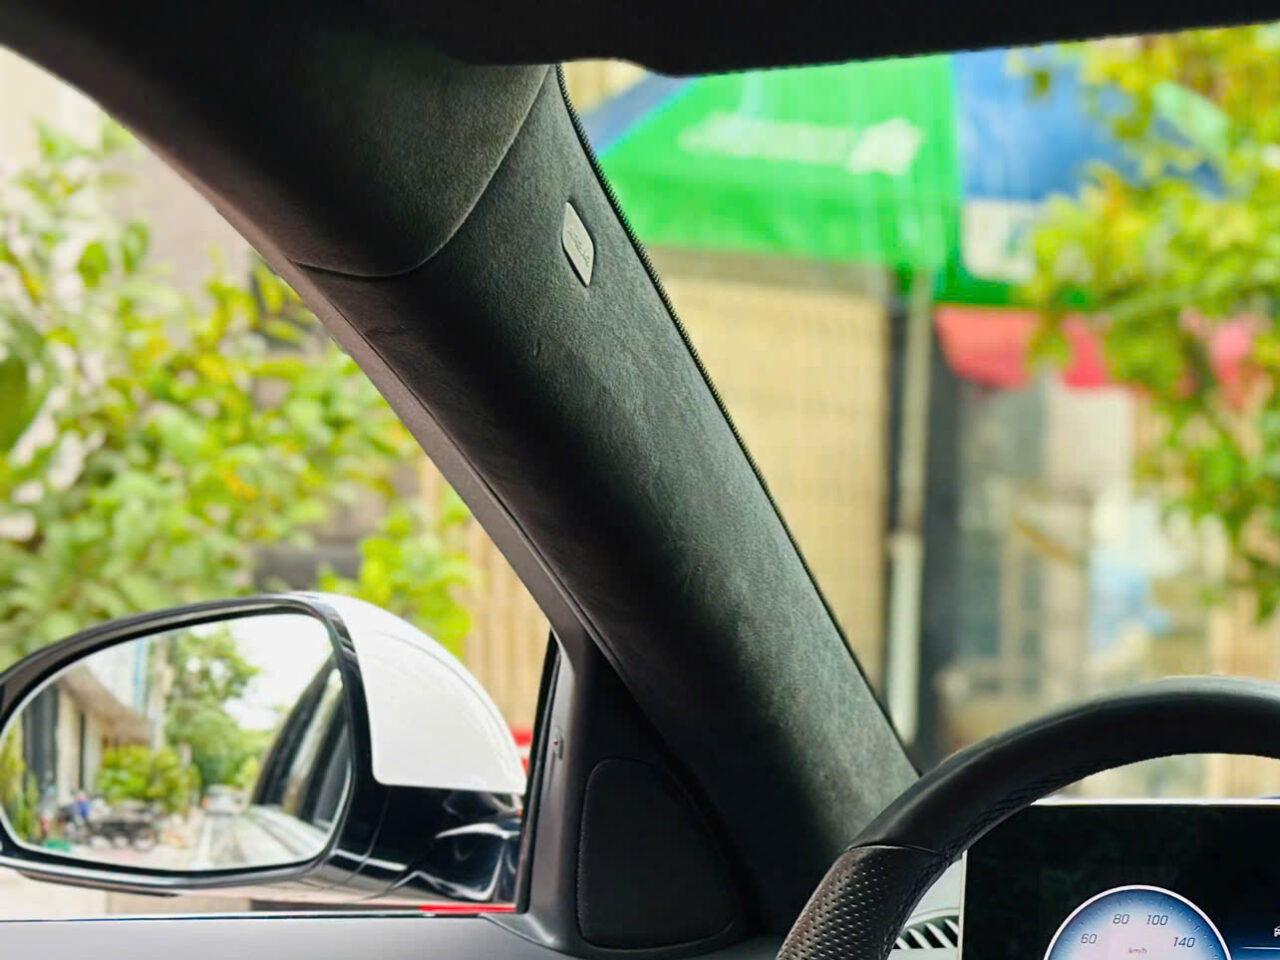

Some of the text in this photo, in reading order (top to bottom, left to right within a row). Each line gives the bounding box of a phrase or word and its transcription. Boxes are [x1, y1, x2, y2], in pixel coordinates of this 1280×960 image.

[1112, 913, 1130, 925] 80
[1146, 914, 1169, 926] 100
[1080, 933, 1098, 945] 60
[1173, 936, 1196, 948] 140
